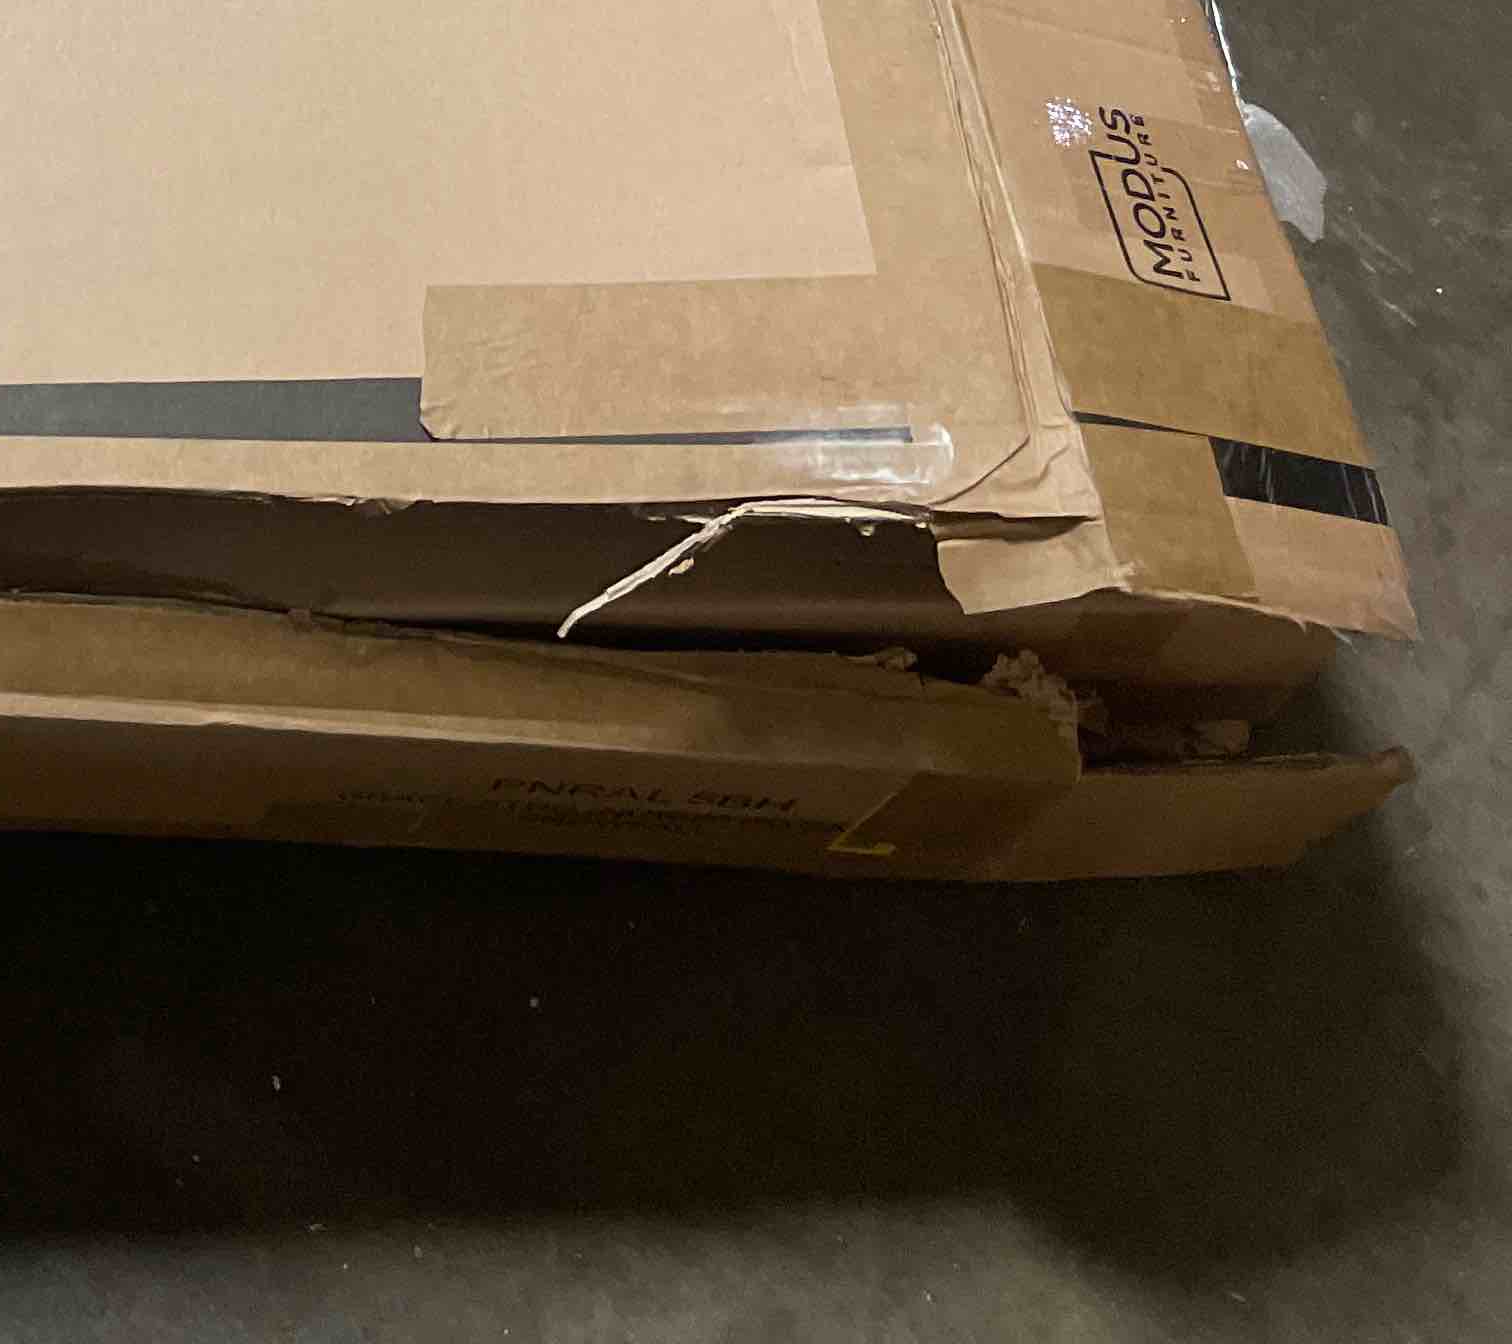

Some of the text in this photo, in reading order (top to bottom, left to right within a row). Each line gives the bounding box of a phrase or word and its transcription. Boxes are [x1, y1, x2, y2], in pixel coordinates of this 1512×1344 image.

[1099, 107, 1185, 279] MODUS
[1130, 115, 1201, 282] FURNITURE
[491, 776, 670, 801] PNRAL
